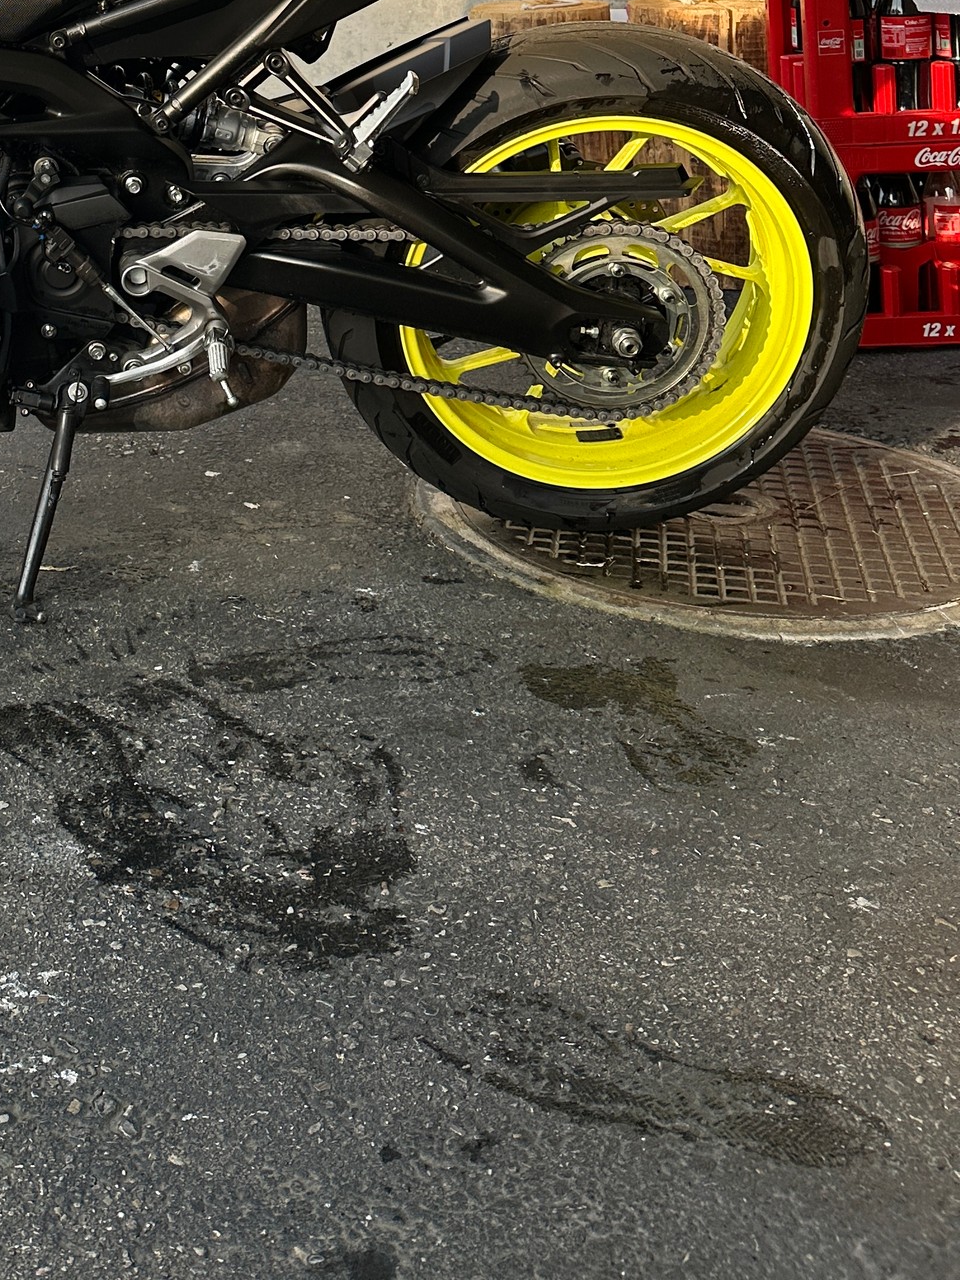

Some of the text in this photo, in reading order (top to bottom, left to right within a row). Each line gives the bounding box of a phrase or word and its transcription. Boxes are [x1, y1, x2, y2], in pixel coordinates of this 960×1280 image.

[907, 120, 929, 137] 12
[931, 123, 945, 136] x
[922, 322, 956, 337] 12 x
